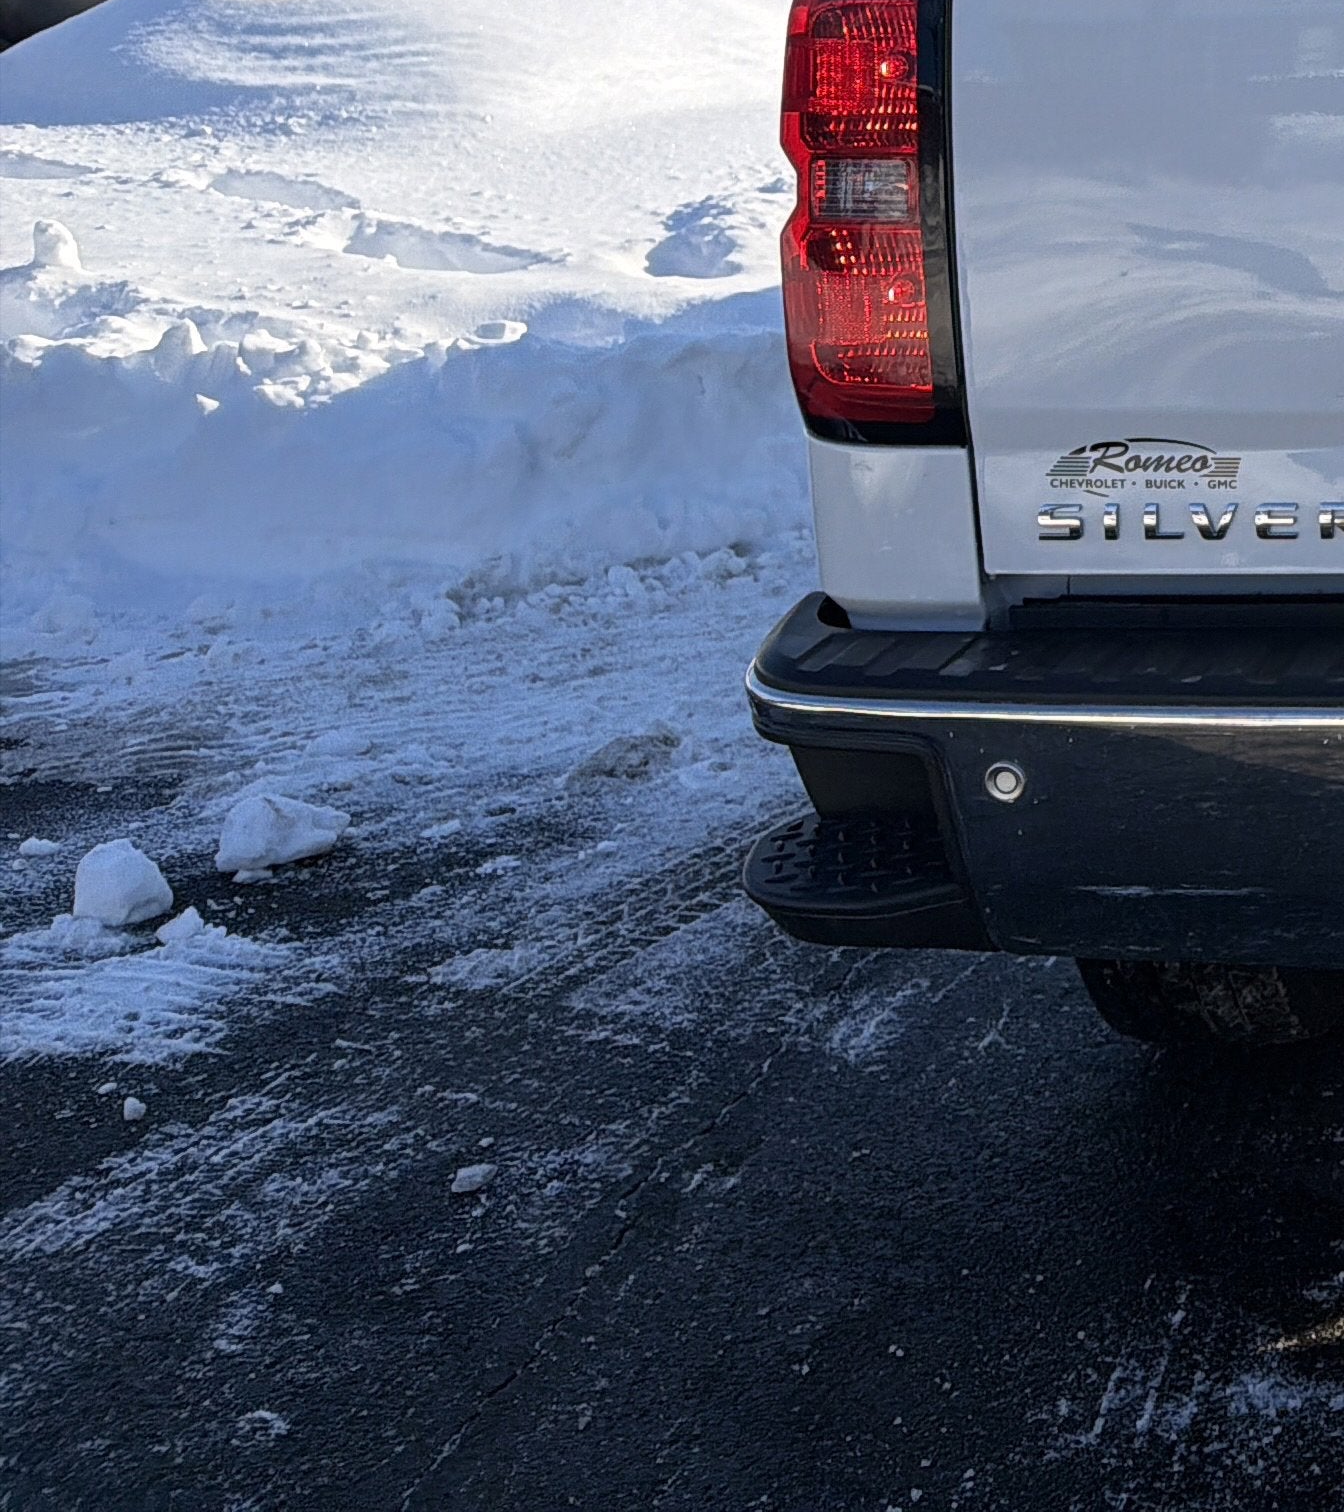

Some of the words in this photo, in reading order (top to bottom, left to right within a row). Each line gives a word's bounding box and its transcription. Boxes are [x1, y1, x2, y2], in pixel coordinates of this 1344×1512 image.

[1088, 441, 1212, 474] Romeo
[1050, 478, 1127, 489] CHEVROLET
[1145, 479, 1185, 489] BUICK
[1207, 479, 1238, 490] GMC
